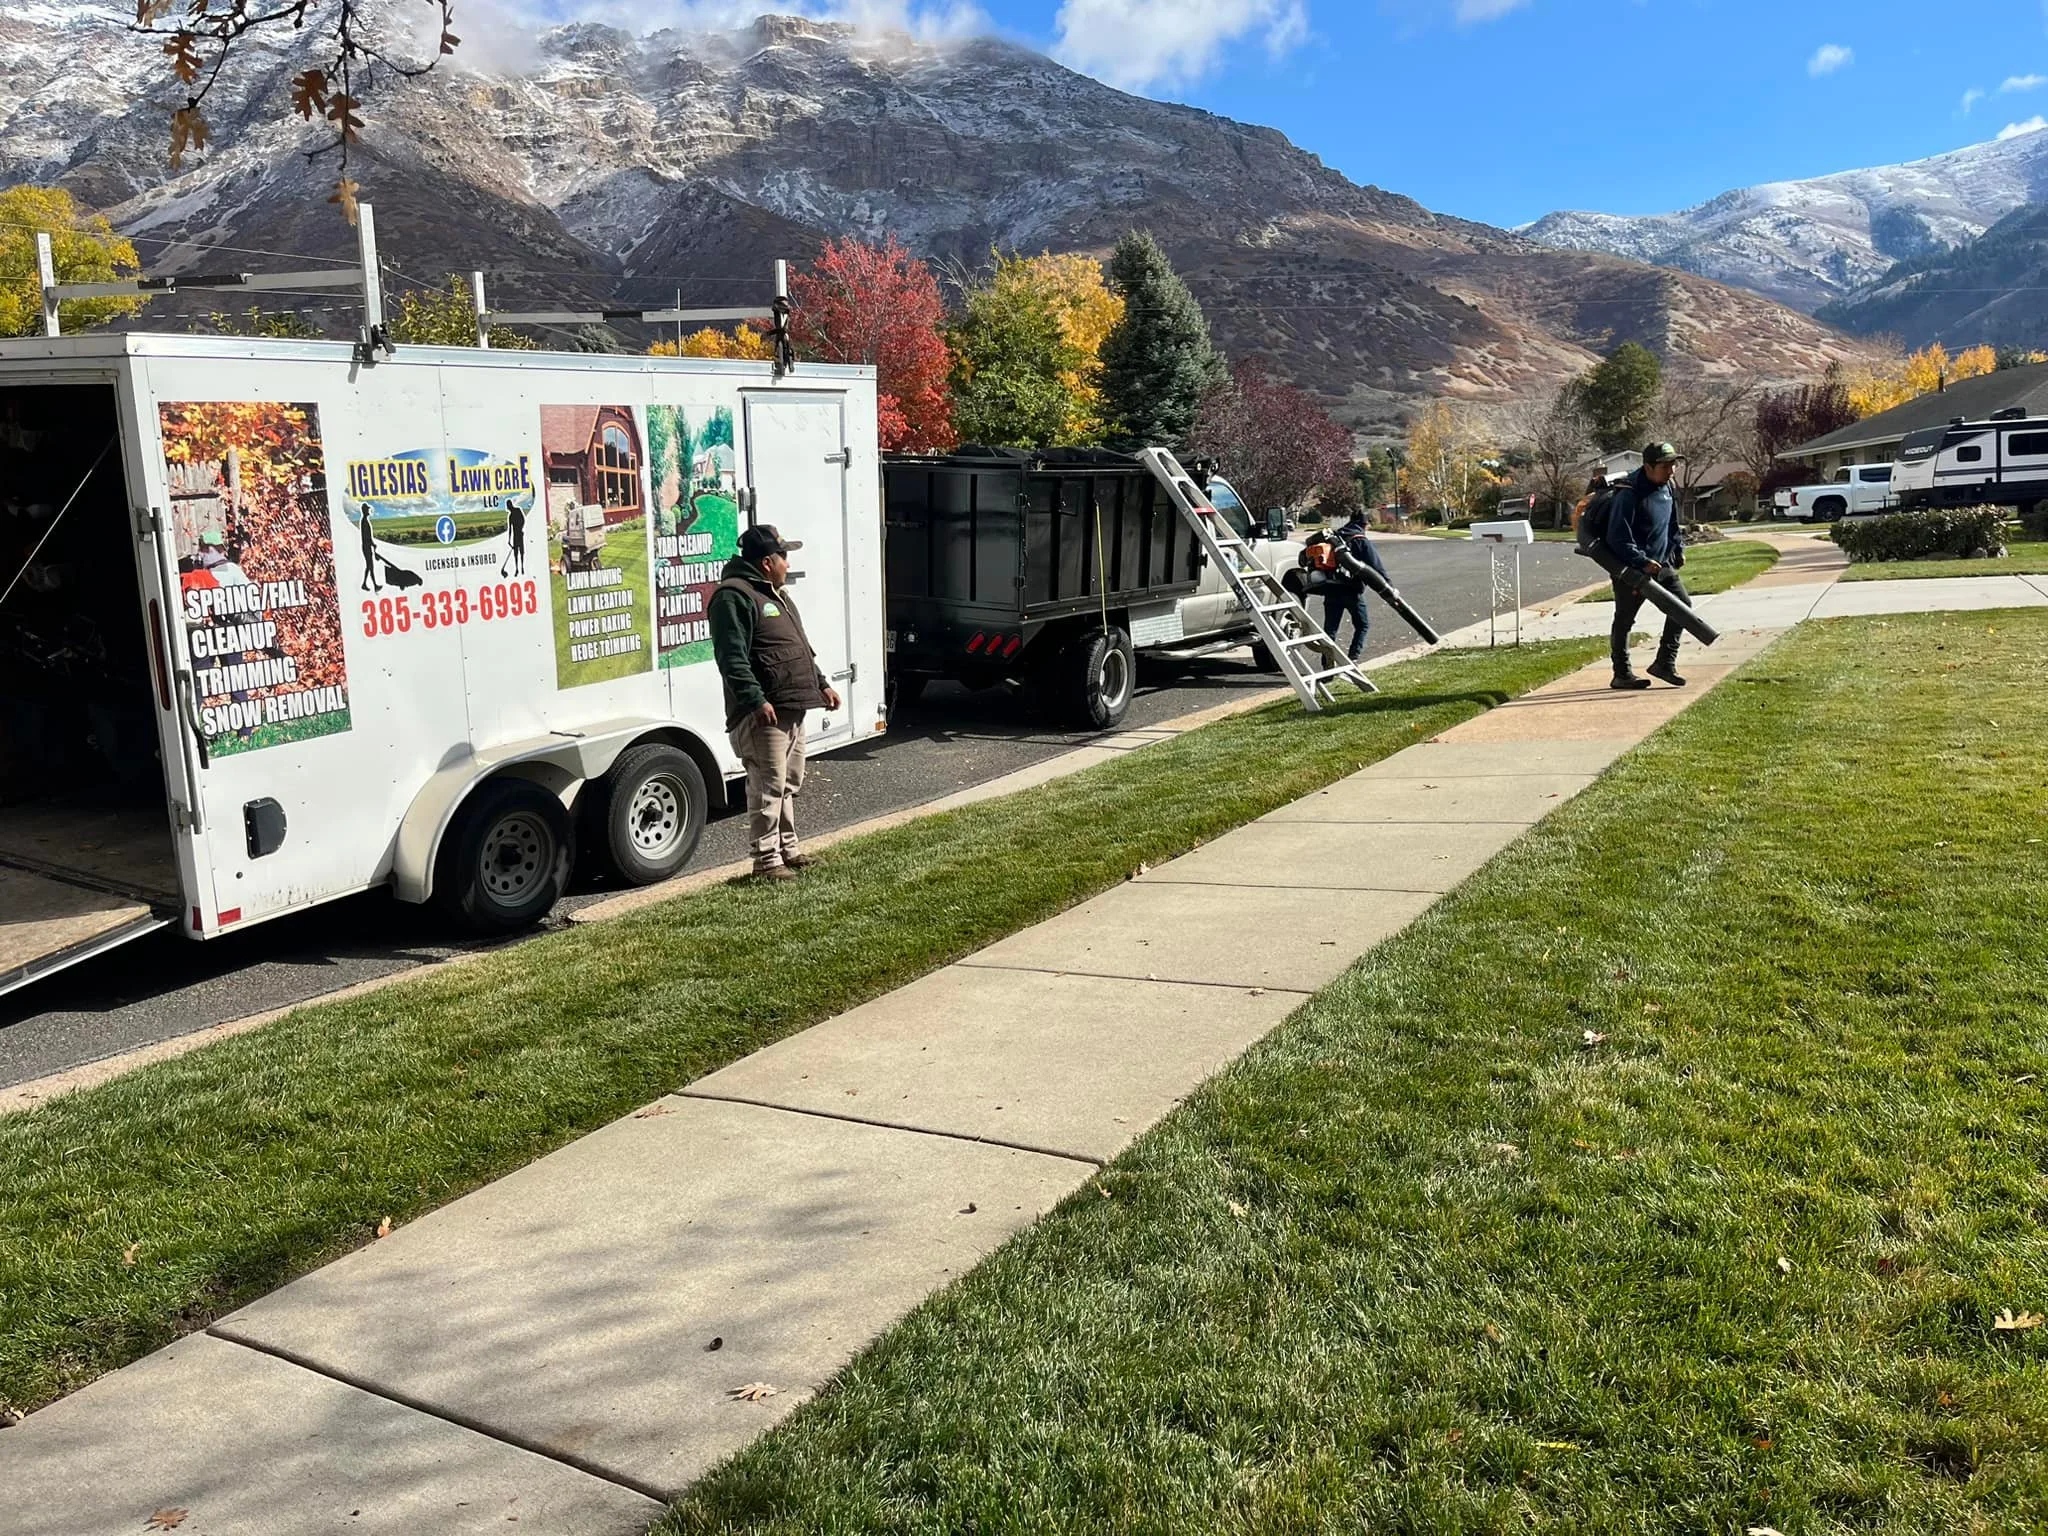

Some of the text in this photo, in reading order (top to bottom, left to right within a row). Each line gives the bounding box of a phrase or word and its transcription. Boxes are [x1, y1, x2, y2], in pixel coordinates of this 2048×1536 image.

[349, 456, 531, 497] IGLESIAS LAWN CARE
[483, 495, 500, 508] LLC
[657, 533, 713, 557] YARD CLEANUP
[425, 553, 497, 571] LICENSED & INSURED
[658, 562, 706, 588] SPRINKLER
[566, 567, 622, 591] LAWN MOWING
[186, 579, 308, 619] SPRING/FALL
[361, 580, 538, 638] 385-333-6993
[568, 589, 633, 614] LAWN AERATION
[659, 592, 703, 617] PLANTING
[191, 620, 277, 658] CLEANUP
[569, 613, 632, 639] POWER RAKING
[661, 622, 692, 647] MULCH
[571, 634, 641, 662] HEDGE TRIMMING
[196, 656, 298, 697] TRIMMING
[202, 685, 347, 736] SNOW REMOVAL
